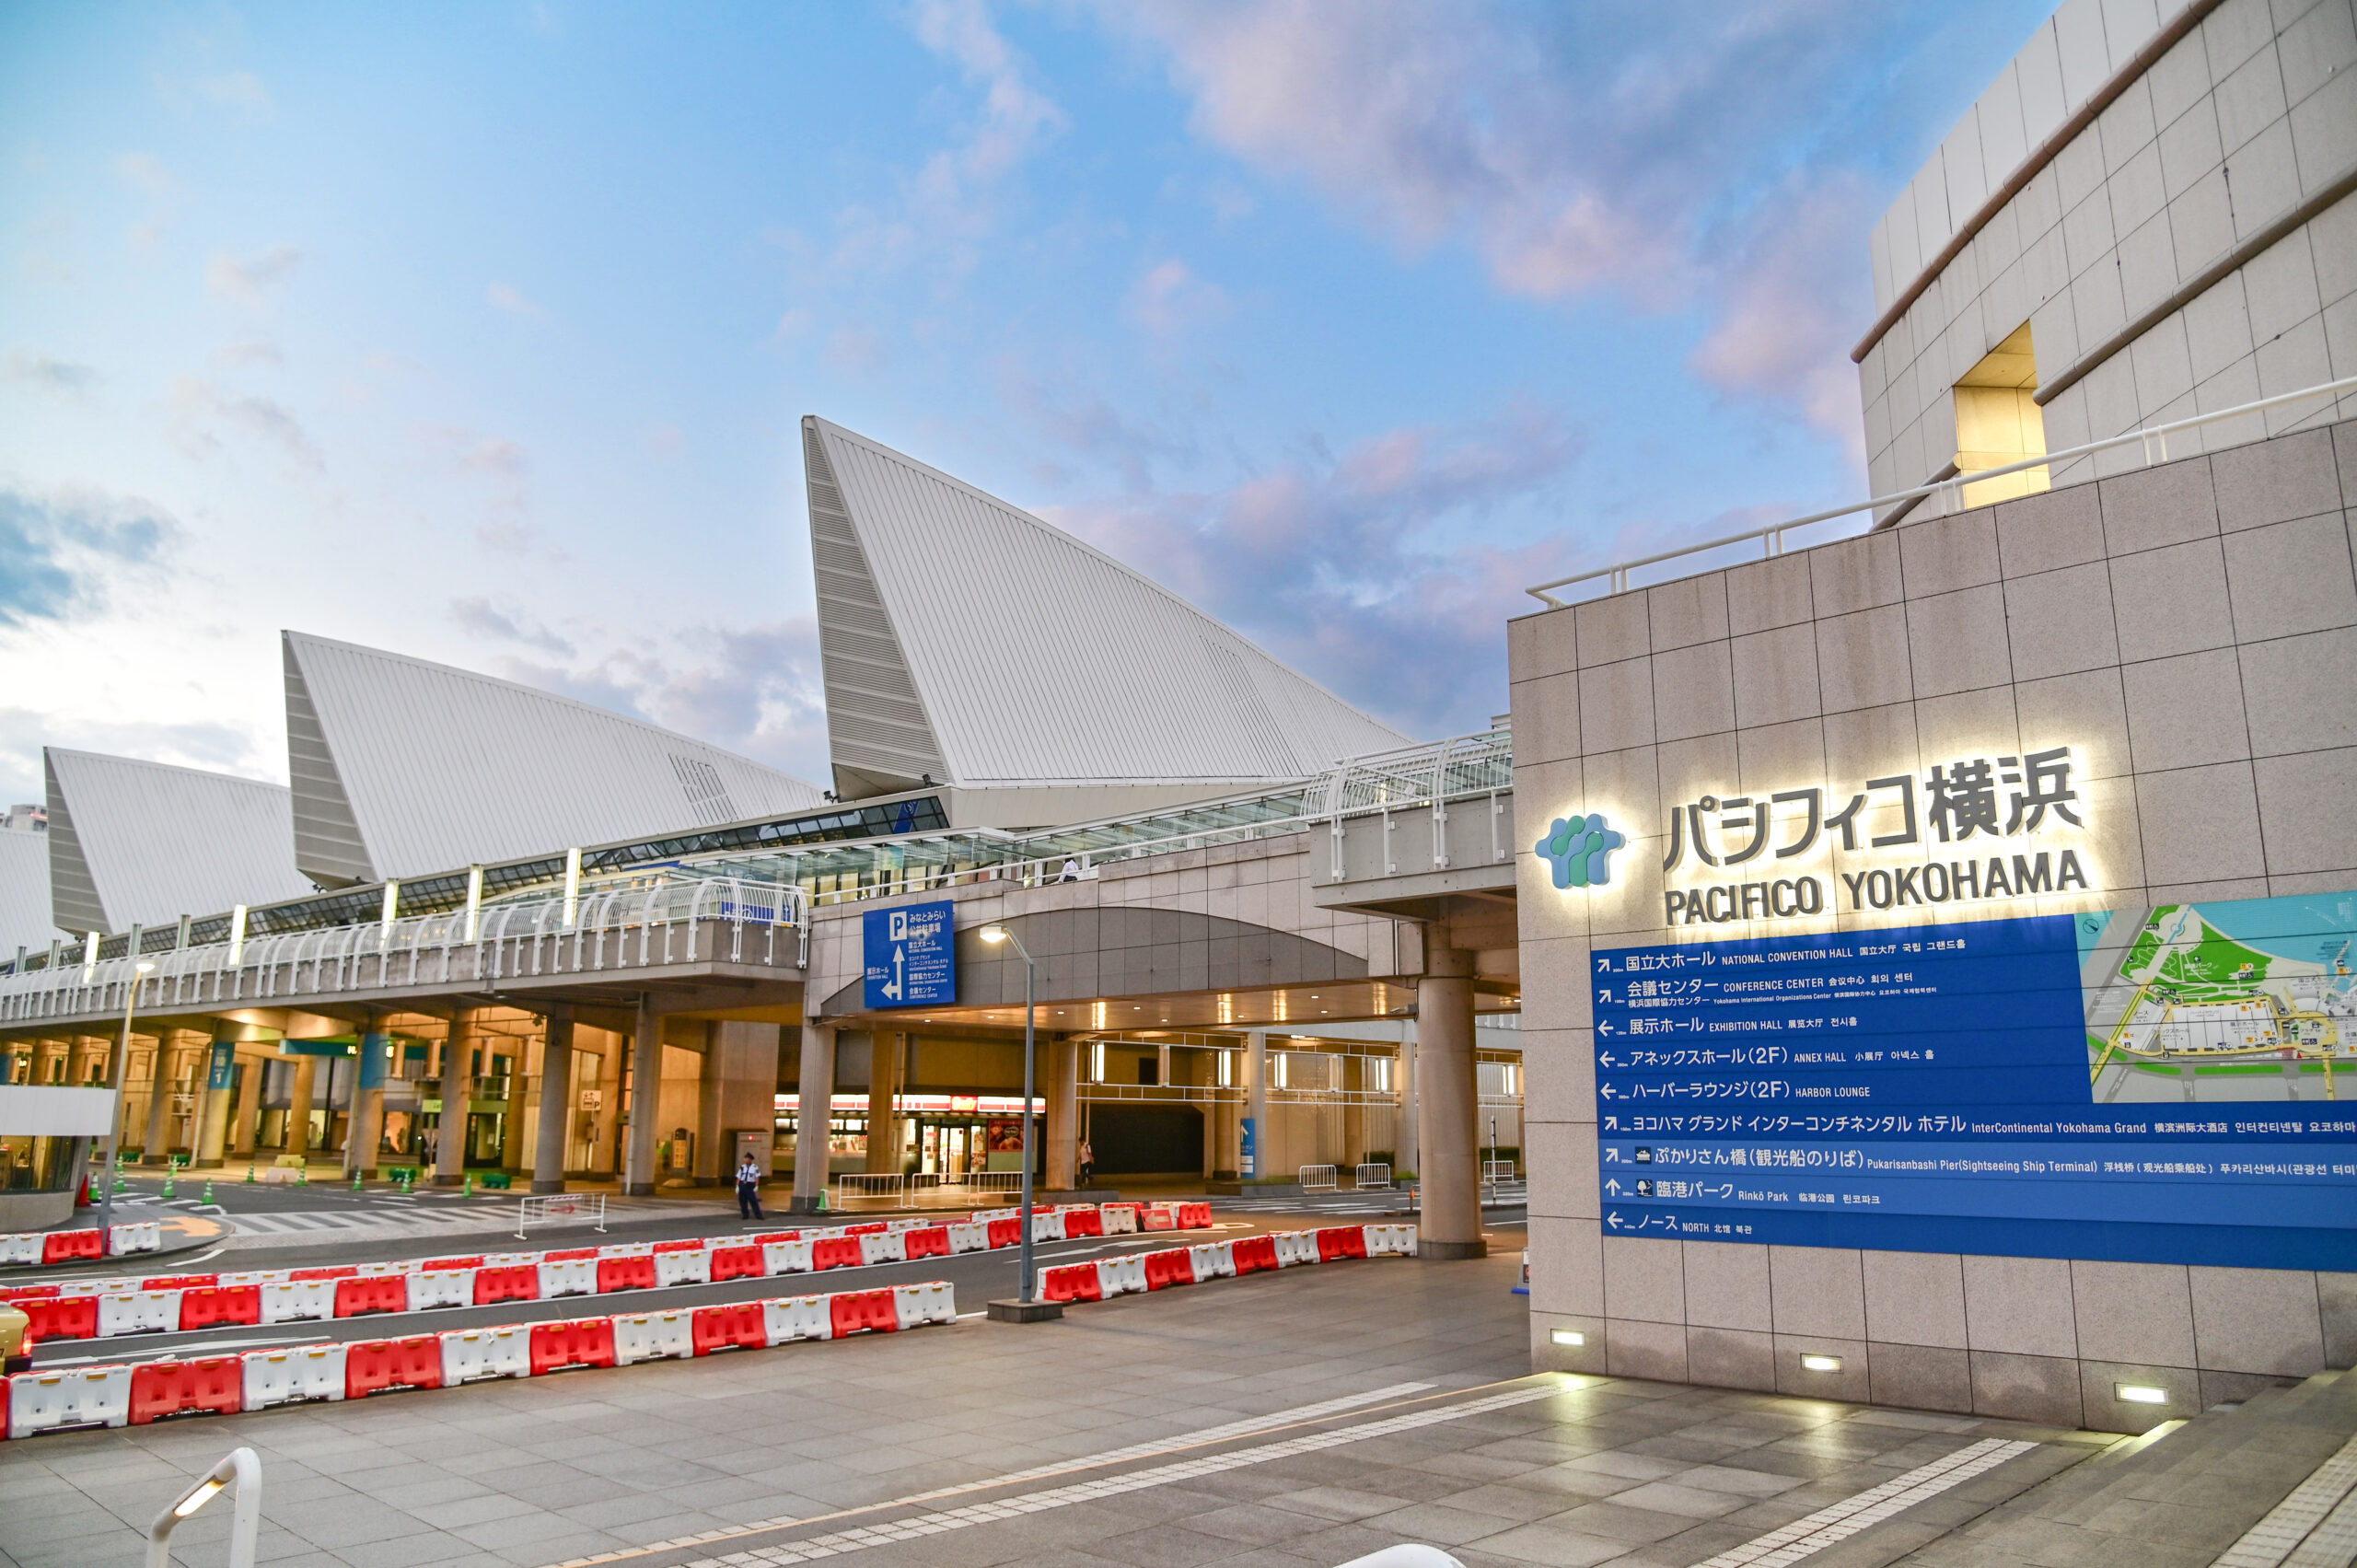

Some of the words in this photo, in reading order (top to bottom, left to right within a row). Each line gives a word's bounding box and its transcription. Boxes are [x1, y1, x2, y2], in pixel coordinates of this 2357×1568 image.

[1663, 746, 2083, 870] パシフィコ横浜
[1666, 877, 1821, 925] PACIFICO
[1842, 850, 2087, 910] YOKOHAMA
[910, 911, 946, 923] みなとみらい
[895, 916, 903, 936] P
[1860, 945, 1896, 956] 国立大厅
[1902, 943, 1921, 952] 국립
[1927, 939, 1966, 950] 그랜드홀
[1626, 951, 1715, 971] 国立大ホール
[1722, 954, 1765, 965] NATIONAL
[1768, 950, 1826, 962] CONVENTION
[1829, 947, 1852, 958] HALL
[1829, 976, 1864, 986] 会议中心
[1871, 974, 1888, 983] 회의
[1895, 972, 1912, 982] 센터
[1628, 979, 1718, 997] 会議センター
[1724, 981, 1782, 993] CONFERENCE
[1786, 978, 1823, 989] CENTER
[1629, 996, 1710, 1008] 横浜国際協力センター
[1630, 1017, 1704, 1034] 展示ホール
[1710, 1021, 1757, 1031] EXHIBITION
[1760, 1020, 1782, 1029] HALL
[1788, 1018, 1823, 1028] 展览大厅
[1831, 1016, 1857, 1027] 전시홀
[1794, 1053, 1822, 1063] ANNEX
[1825, 1052, 1846, 1062] HALL
[1855, 1051, 1883, 1061] 小展厅
[1891, 1051, 1920, 1060] 아넥스
[1795, 1087, 1831, 1097] HARBOR
[1834, 1087, 1870, 1097] LOUNGE
[1633, 1117, 1683, 1130] ヨコハマ
[1689, 1115, 1742, 1131] グランド
[1748, 1116, 1911, 1132] インターコンチネンタル
[1918, 1116, 1966, 1132] ホテル
[1972, 1122, 2052, 1132] InterContinental
[2056, 1122, 2111, 1132] Yokohama
[2115, 1122, 2146, 1132] Grand
[2154, 1122, 2227, 1132] 横滨洲际大酒店
[2235, 1122, 2303, 1132] 인터컨티넨탈
[2310, 1121, 2356, 1132] 요코하마
[1867, 1159, 1936, 1169] Pukarisanbashi
[1941, 1159, 2019, 1173] Pier(Sightseeing
[2023, 1161, 2045, 1173] Ship
[2049, 1161, 2097, 1172] Terminal)
[2221, 1164, 2327, 1175] 푸카리산바시(관광선
[2333, 1165, 2357, 1175] 터미
[1656, 1181, 1733, 1198] 臨港パーク
[1738, 1191, 1764, 1201] Rinkō
[1768, 1191, 1788, 1202] Park
[1799, 1193, 1834, 1202] 临港公园
[1843, 1194, 1880, 1204] 린코파크
[1639, 1215, 1678, 1230] ノース
[1683, 1223, 1709, 1232] NORTH
[1714, 1225, 1730, 1234] 北馆
[1736, 1225, 1752, 1234] 북관
